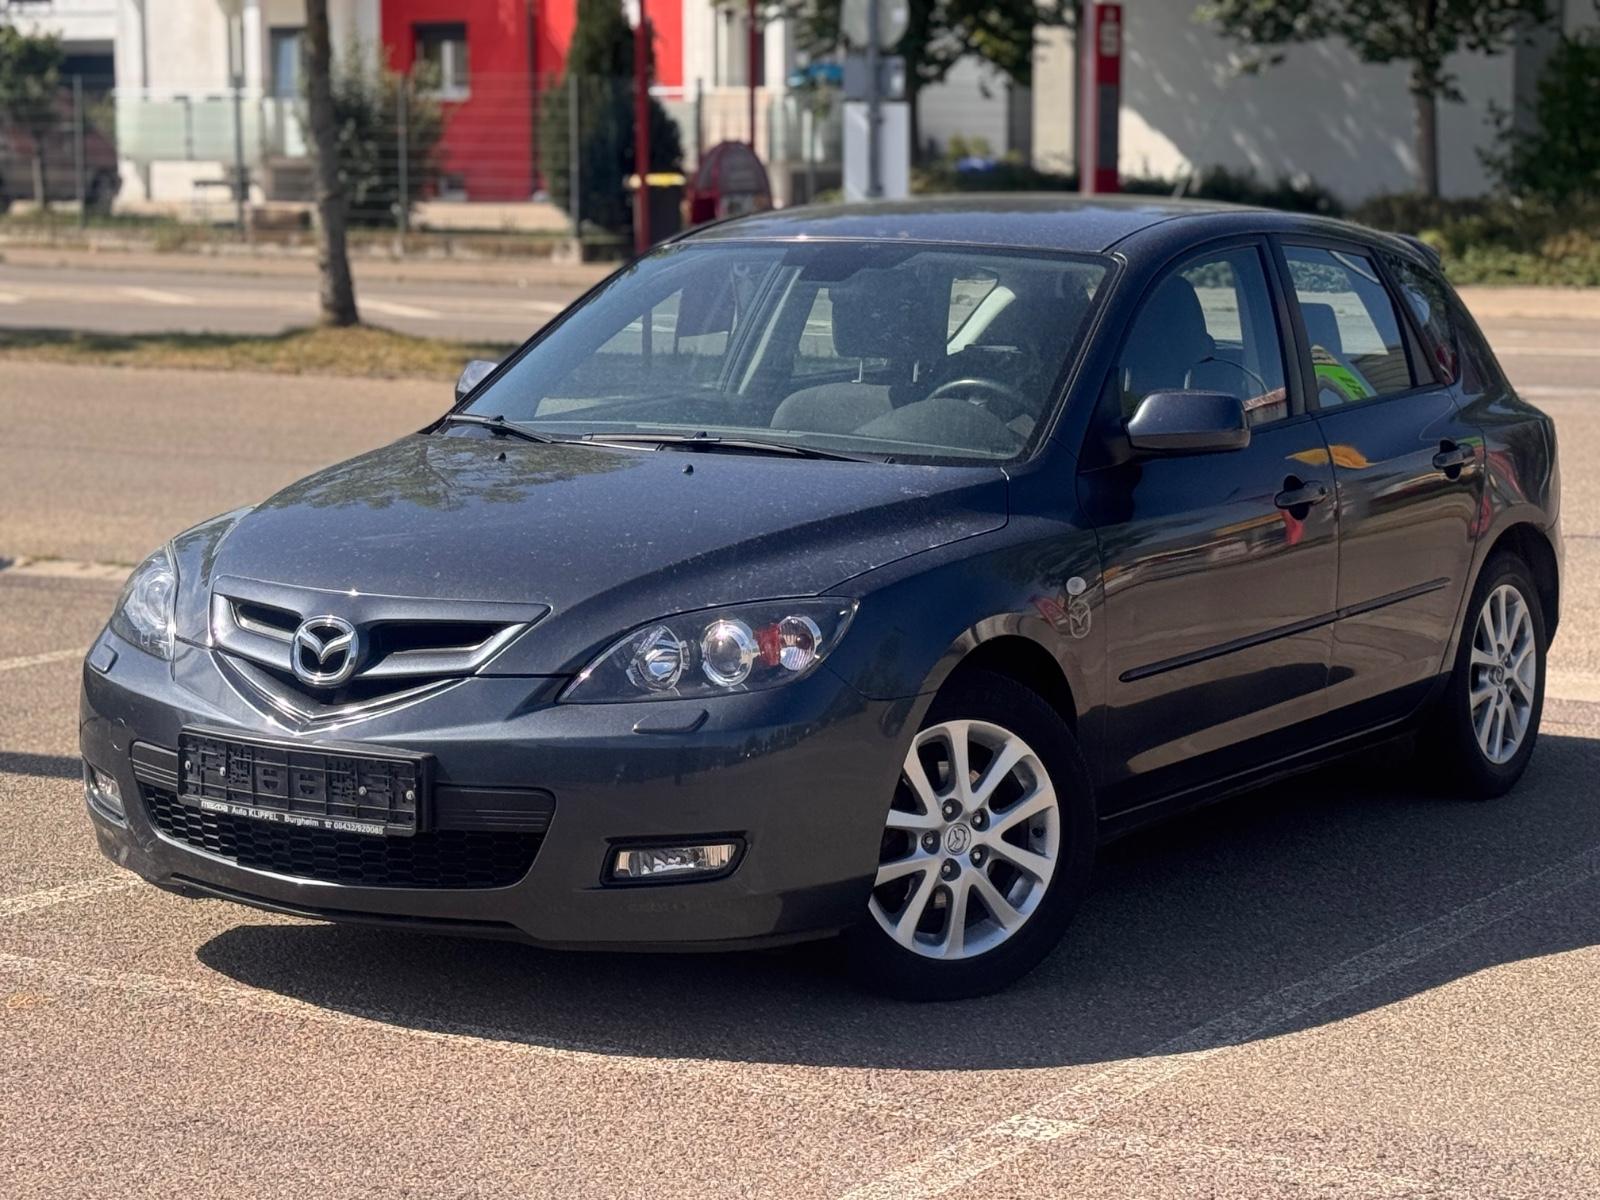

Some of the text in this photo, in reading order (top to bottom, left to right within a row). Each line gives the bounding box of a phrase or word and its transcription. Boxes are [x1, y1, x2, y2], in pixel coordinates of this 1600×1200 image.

[231, 806, 247, 816] Auto
[248, 808, 279, 821] KLIPPEL
[284, 814, 319, 826] Burgheim
